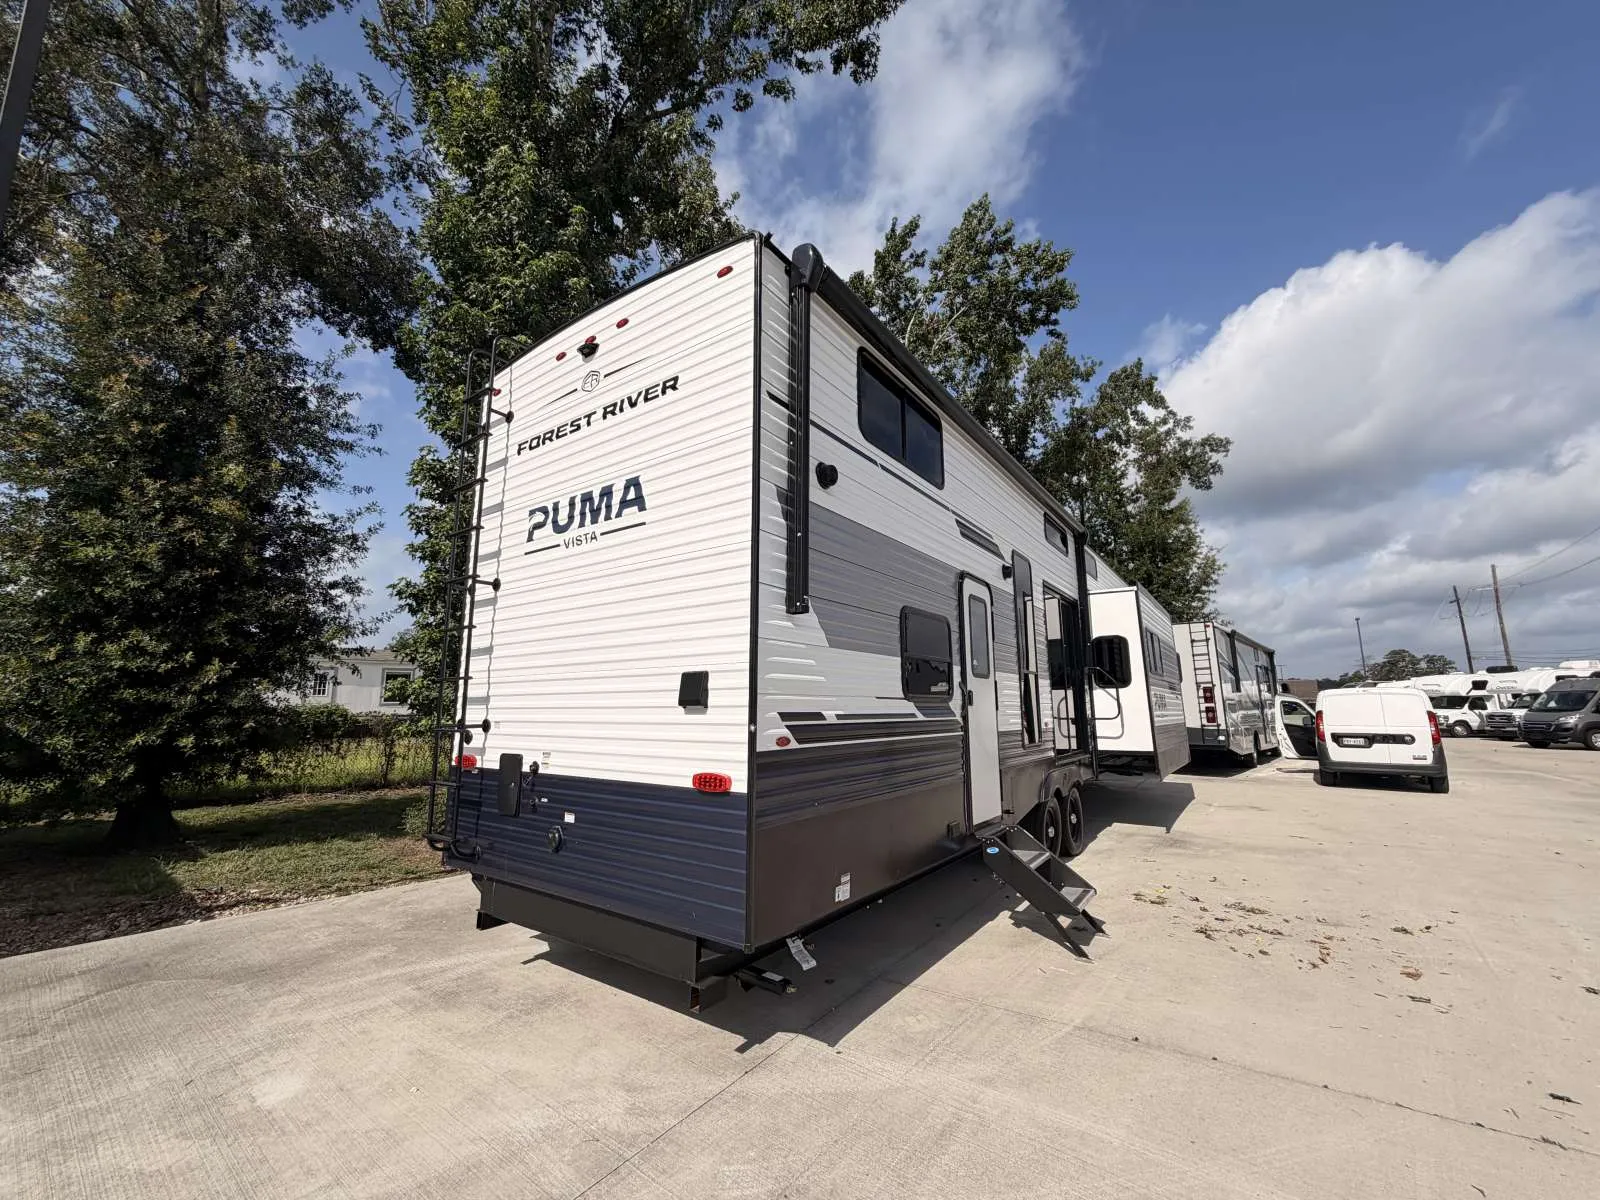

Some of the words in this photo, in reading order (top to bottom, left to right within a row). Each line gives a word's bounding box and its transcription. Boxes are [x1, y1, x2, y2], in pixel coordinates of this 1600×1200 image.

[517, 411, 597, 456] FOREST
[602, 375, 679, 420] RIVER
[526, 475, 647, 543] PUMA
[563, 531, 598, 549] VISTA
